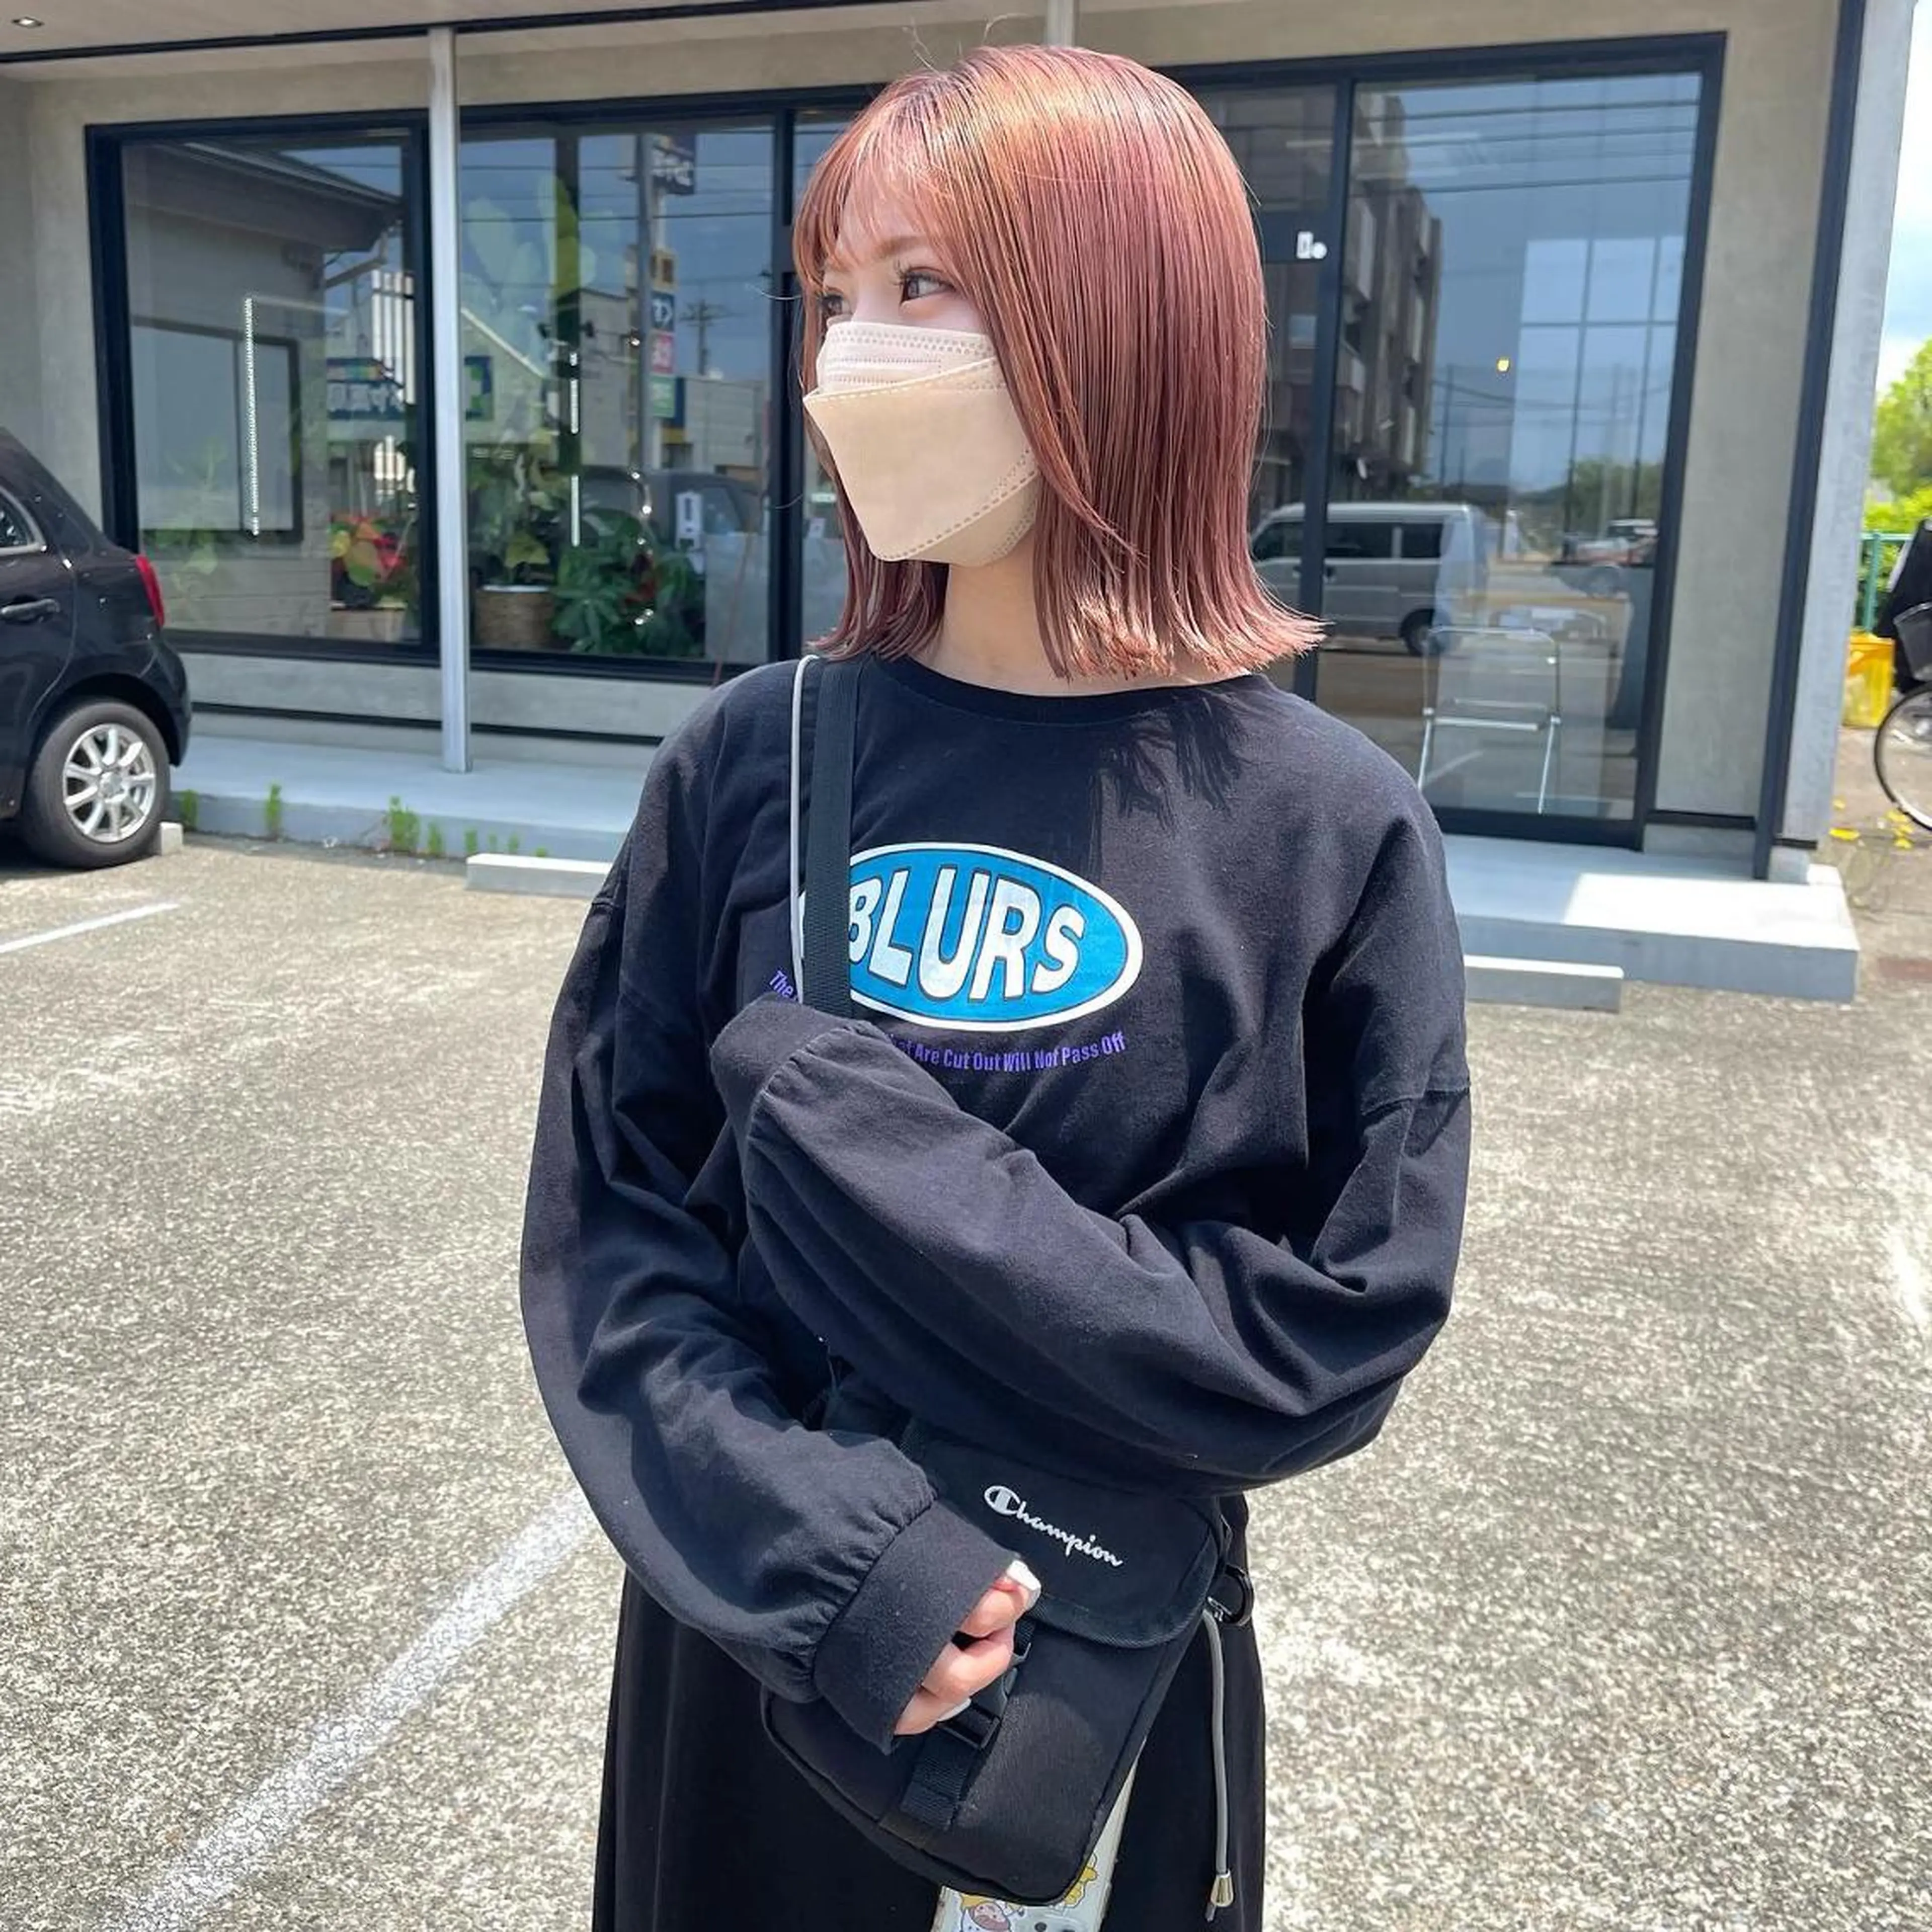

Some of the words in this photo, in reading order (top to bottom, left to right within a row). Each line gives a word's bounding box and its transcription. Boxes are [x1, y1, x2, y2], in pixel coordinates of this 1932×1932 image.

[849, 863, 1087, 1003] BLURS
[768, 969, 794, 999] The
[914, 1043, 939, 1065] Are
[943, 1049, 971, 1070] Cut
[973, 1052, 1001, 1071] Out
[1003, 1051, 1031, 1072] Will
[1062, 1043, 1100, 1067] Pass
[1101, 1030, 1125, 1055] Off
[984, 1485, 1123, 1568] Champion
